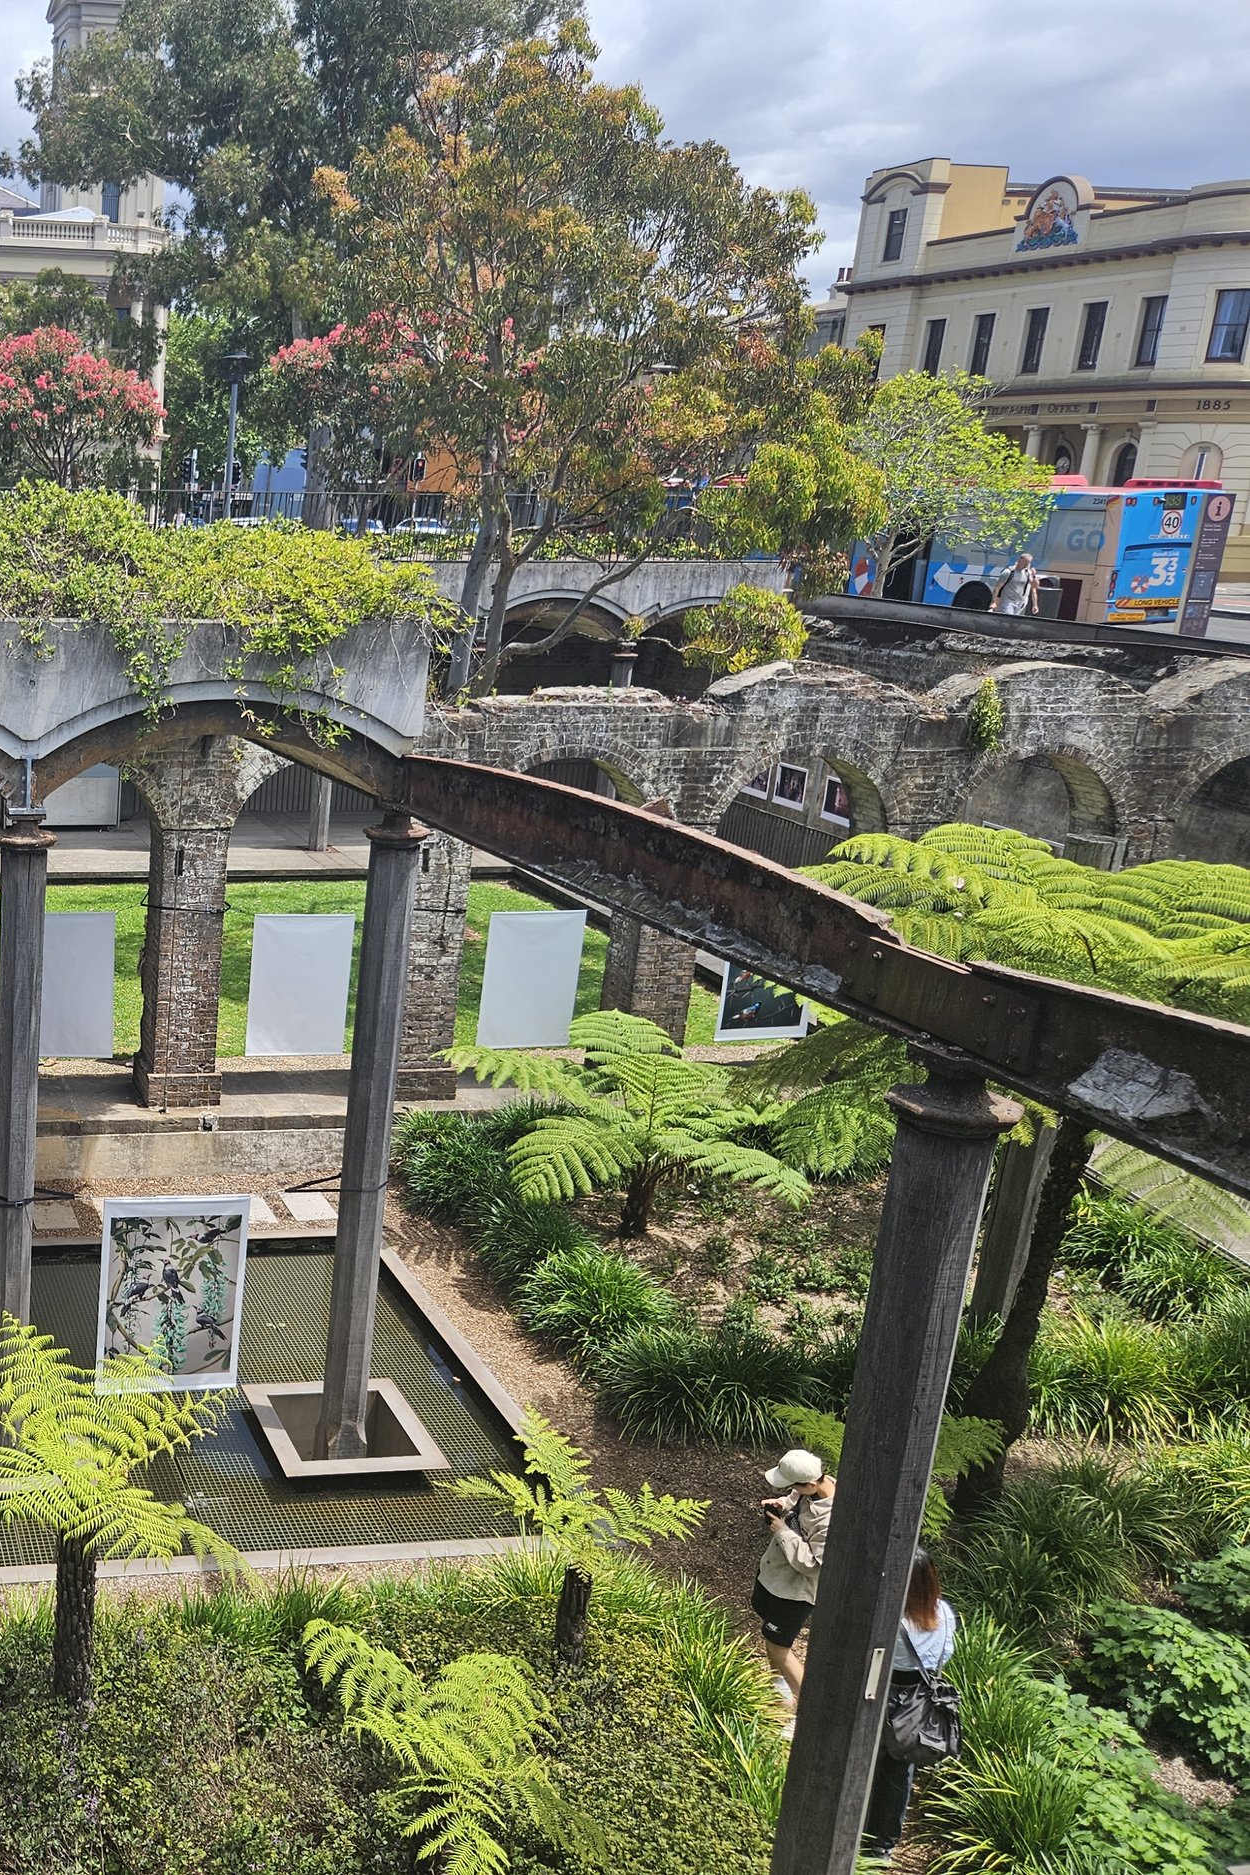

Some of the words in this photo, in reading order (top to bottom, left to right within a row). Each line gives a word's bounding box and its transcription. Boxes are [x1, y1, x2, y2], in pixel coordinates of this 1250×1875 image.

[1196, 400, 1231, 410] 1885
[1164, 516, 1180, 529] 40
[1067, 528, 1105, 552] GO
